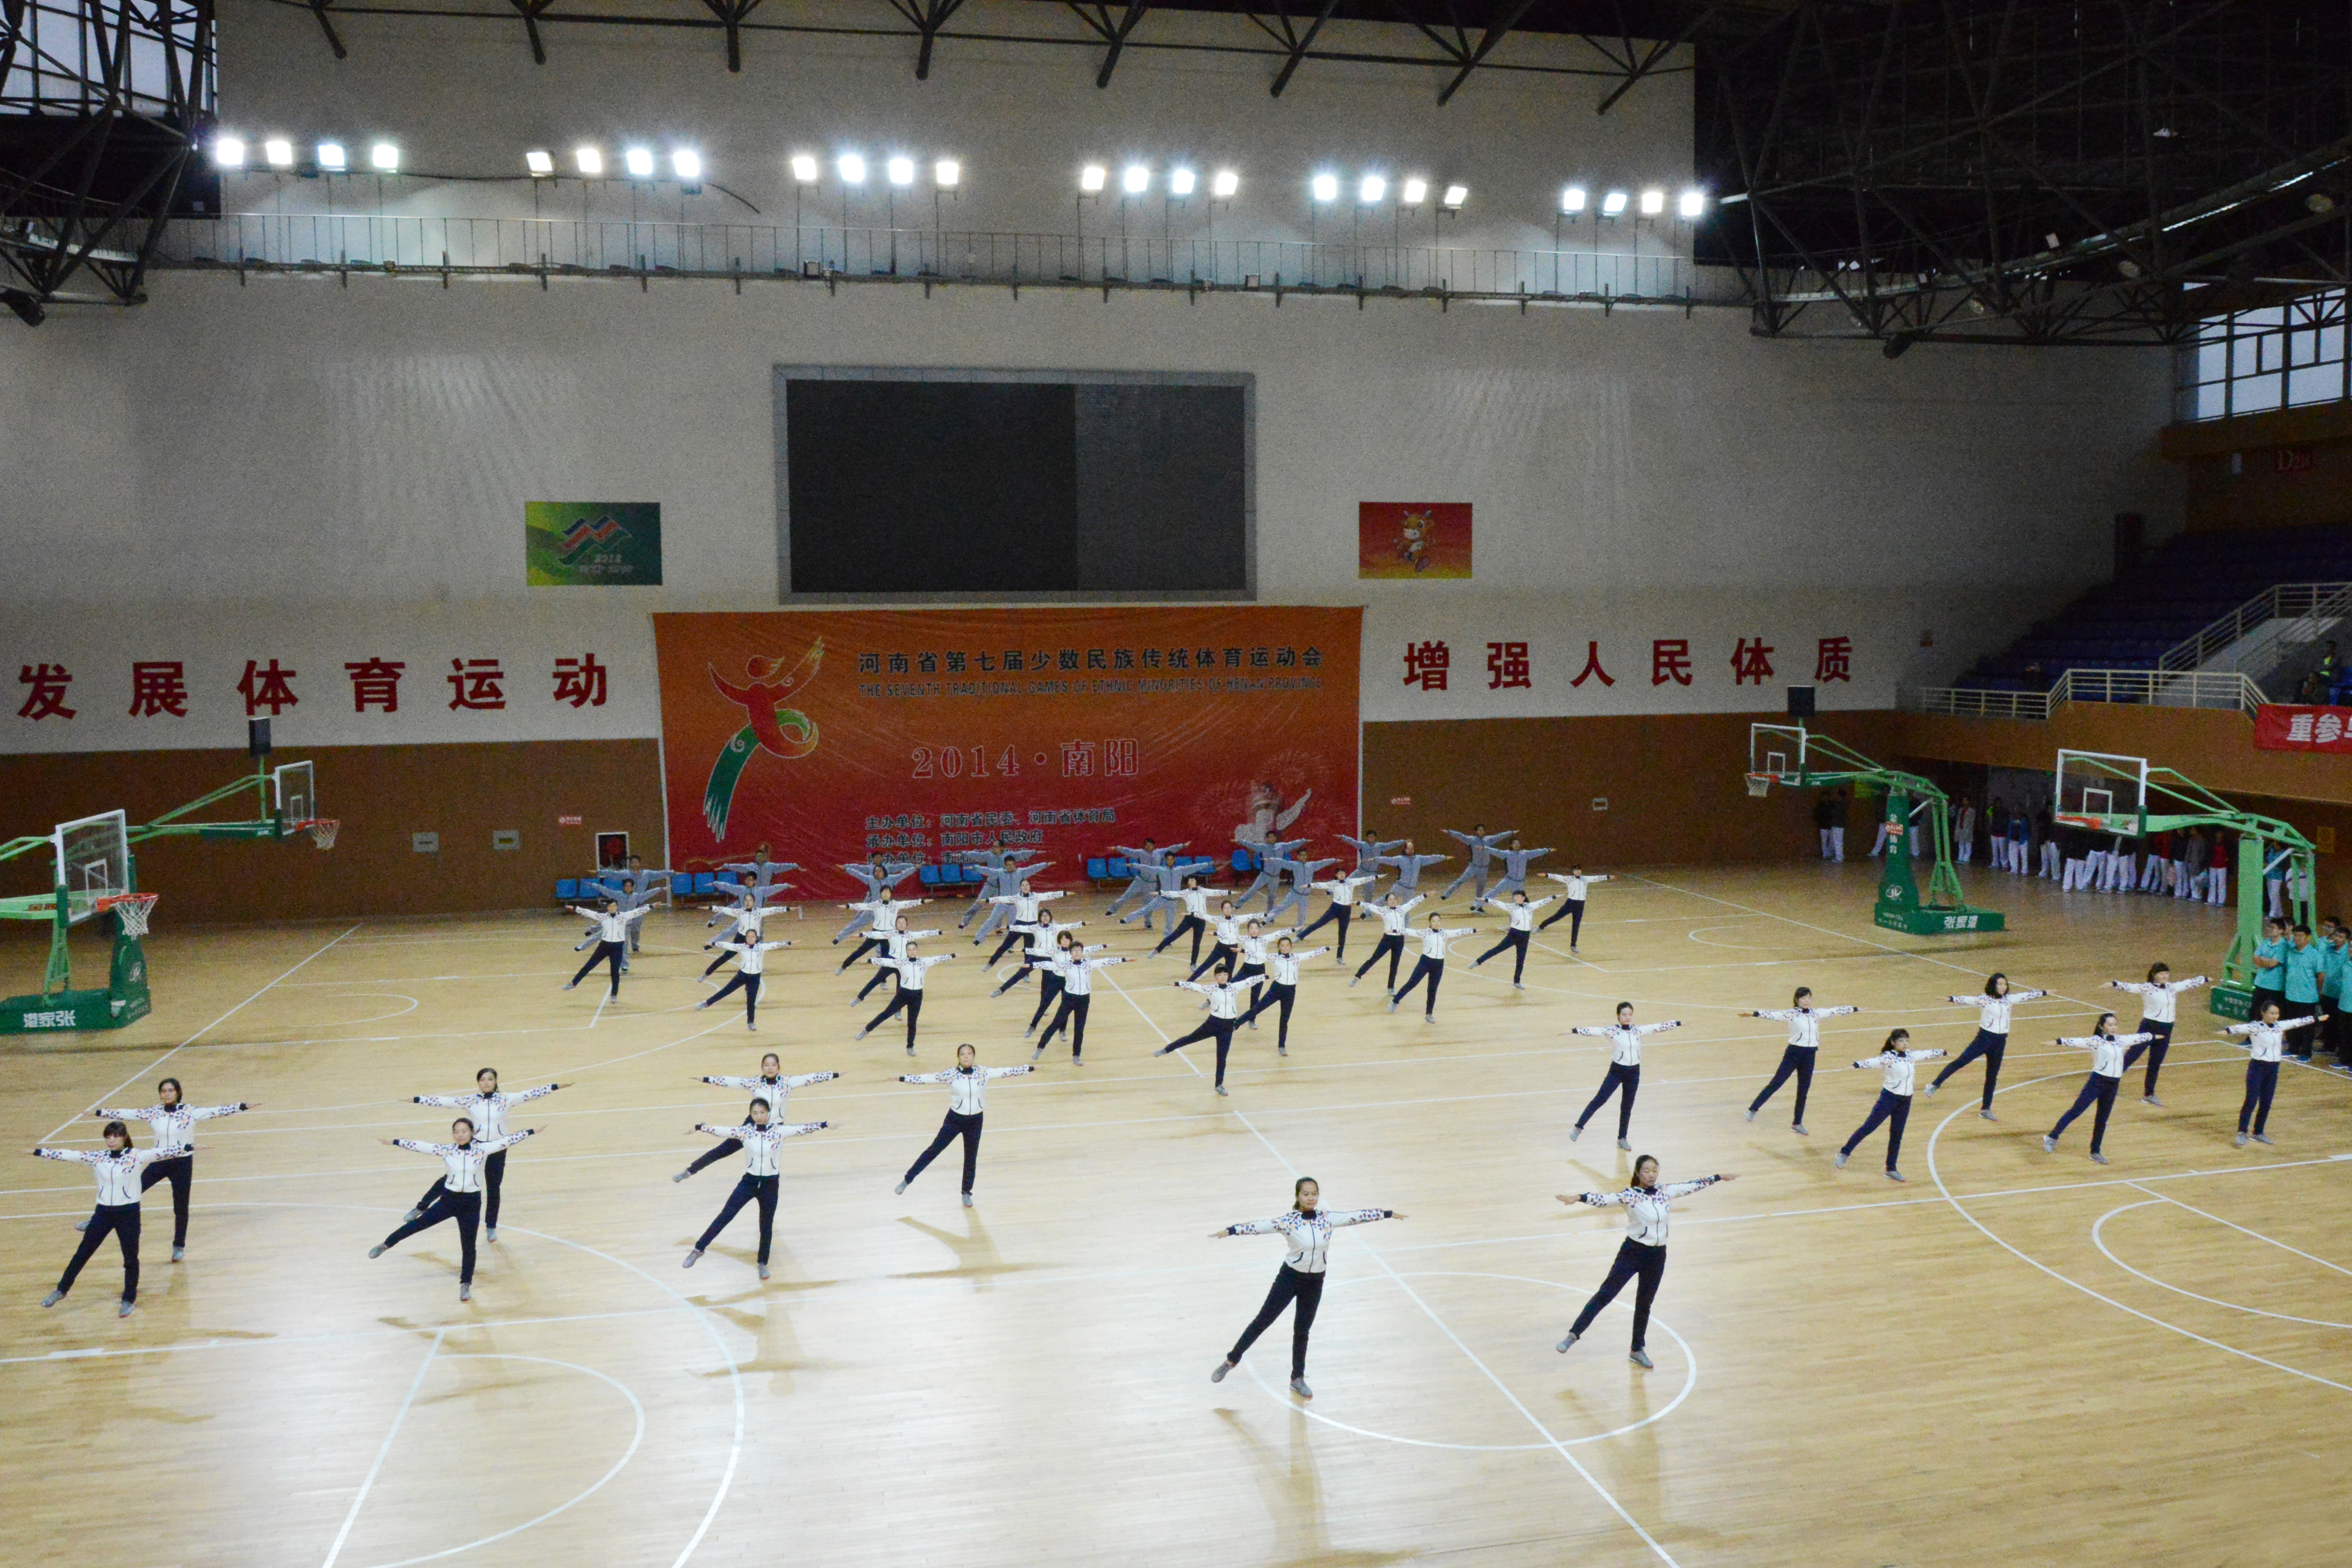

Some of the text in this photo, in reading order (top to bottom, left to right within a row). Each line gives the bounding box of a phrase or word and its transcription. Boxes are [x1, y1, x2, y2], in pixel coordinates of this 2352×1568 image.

[858, 646, 1323, 674] 河南省第七届少数民族传统体育运动会
[1403, 637, 1852, 690] 增强人民体质
[18, 653, 607, 720] 发展体育运动
[858, 676, 1322, 696] THE SEVENTH TRADITIONAL GAMES OF ETHNIC MINORITIES OF HENAN PROVINCE
